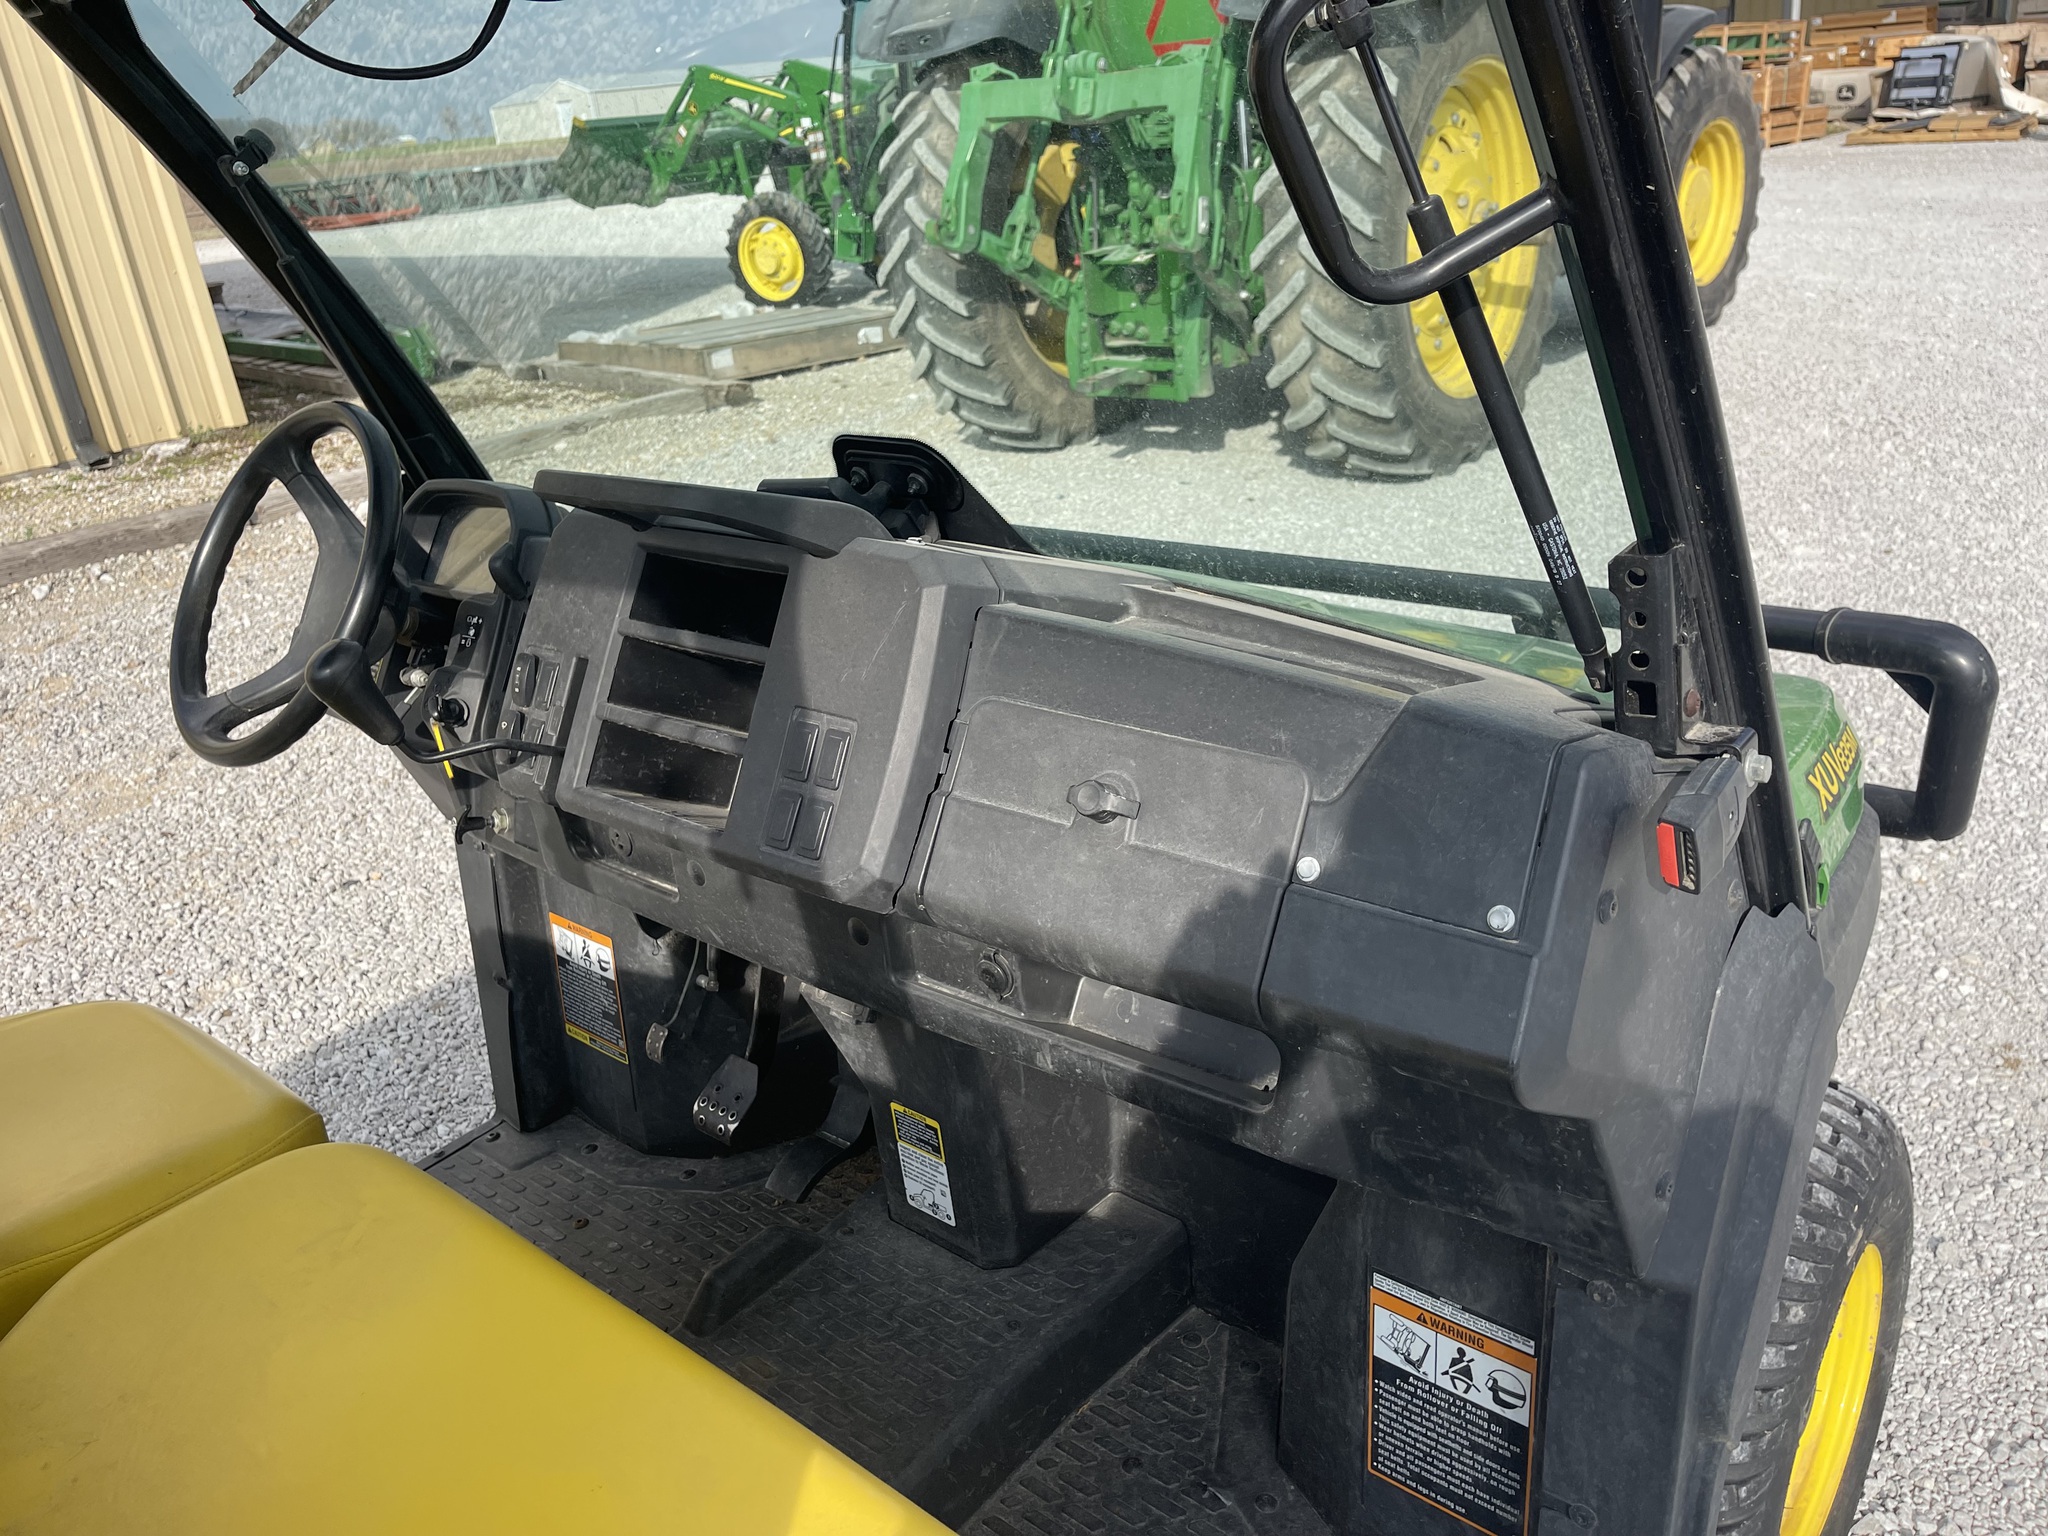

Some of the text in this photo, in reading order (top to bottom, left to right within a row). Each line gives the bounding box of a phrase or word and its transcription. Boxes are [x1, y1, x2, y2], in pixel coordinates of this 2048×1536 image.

[1808, 725, 1858, 812] XUV835M
[1430, 1316, 1485, 1350] WARNING
[1379, 1389, 1406, 1408] Passenger
[1408, 1403, 1421, 1414] must
[1451, 1424, 1466, 1438] grasp
[1498, 1446, 1511, 1458] with
[1396, 1378, 1502, 1435] From Rollover or Falling Off
[1397, 1389, 1411, 1401] video
[1413, 1397, 1423, 1407] and
[1424, 1402, 1436, 1413] read
[1490, 1433, 1508, 1449] before
[1409, 1375, 1489, 1420] Avoid Injury or Death
[1411, 1413, 1421, 1423] and
[1431, 1449, 1450, 1464] driving
[1499, 1483, 1515, 1497] rough
